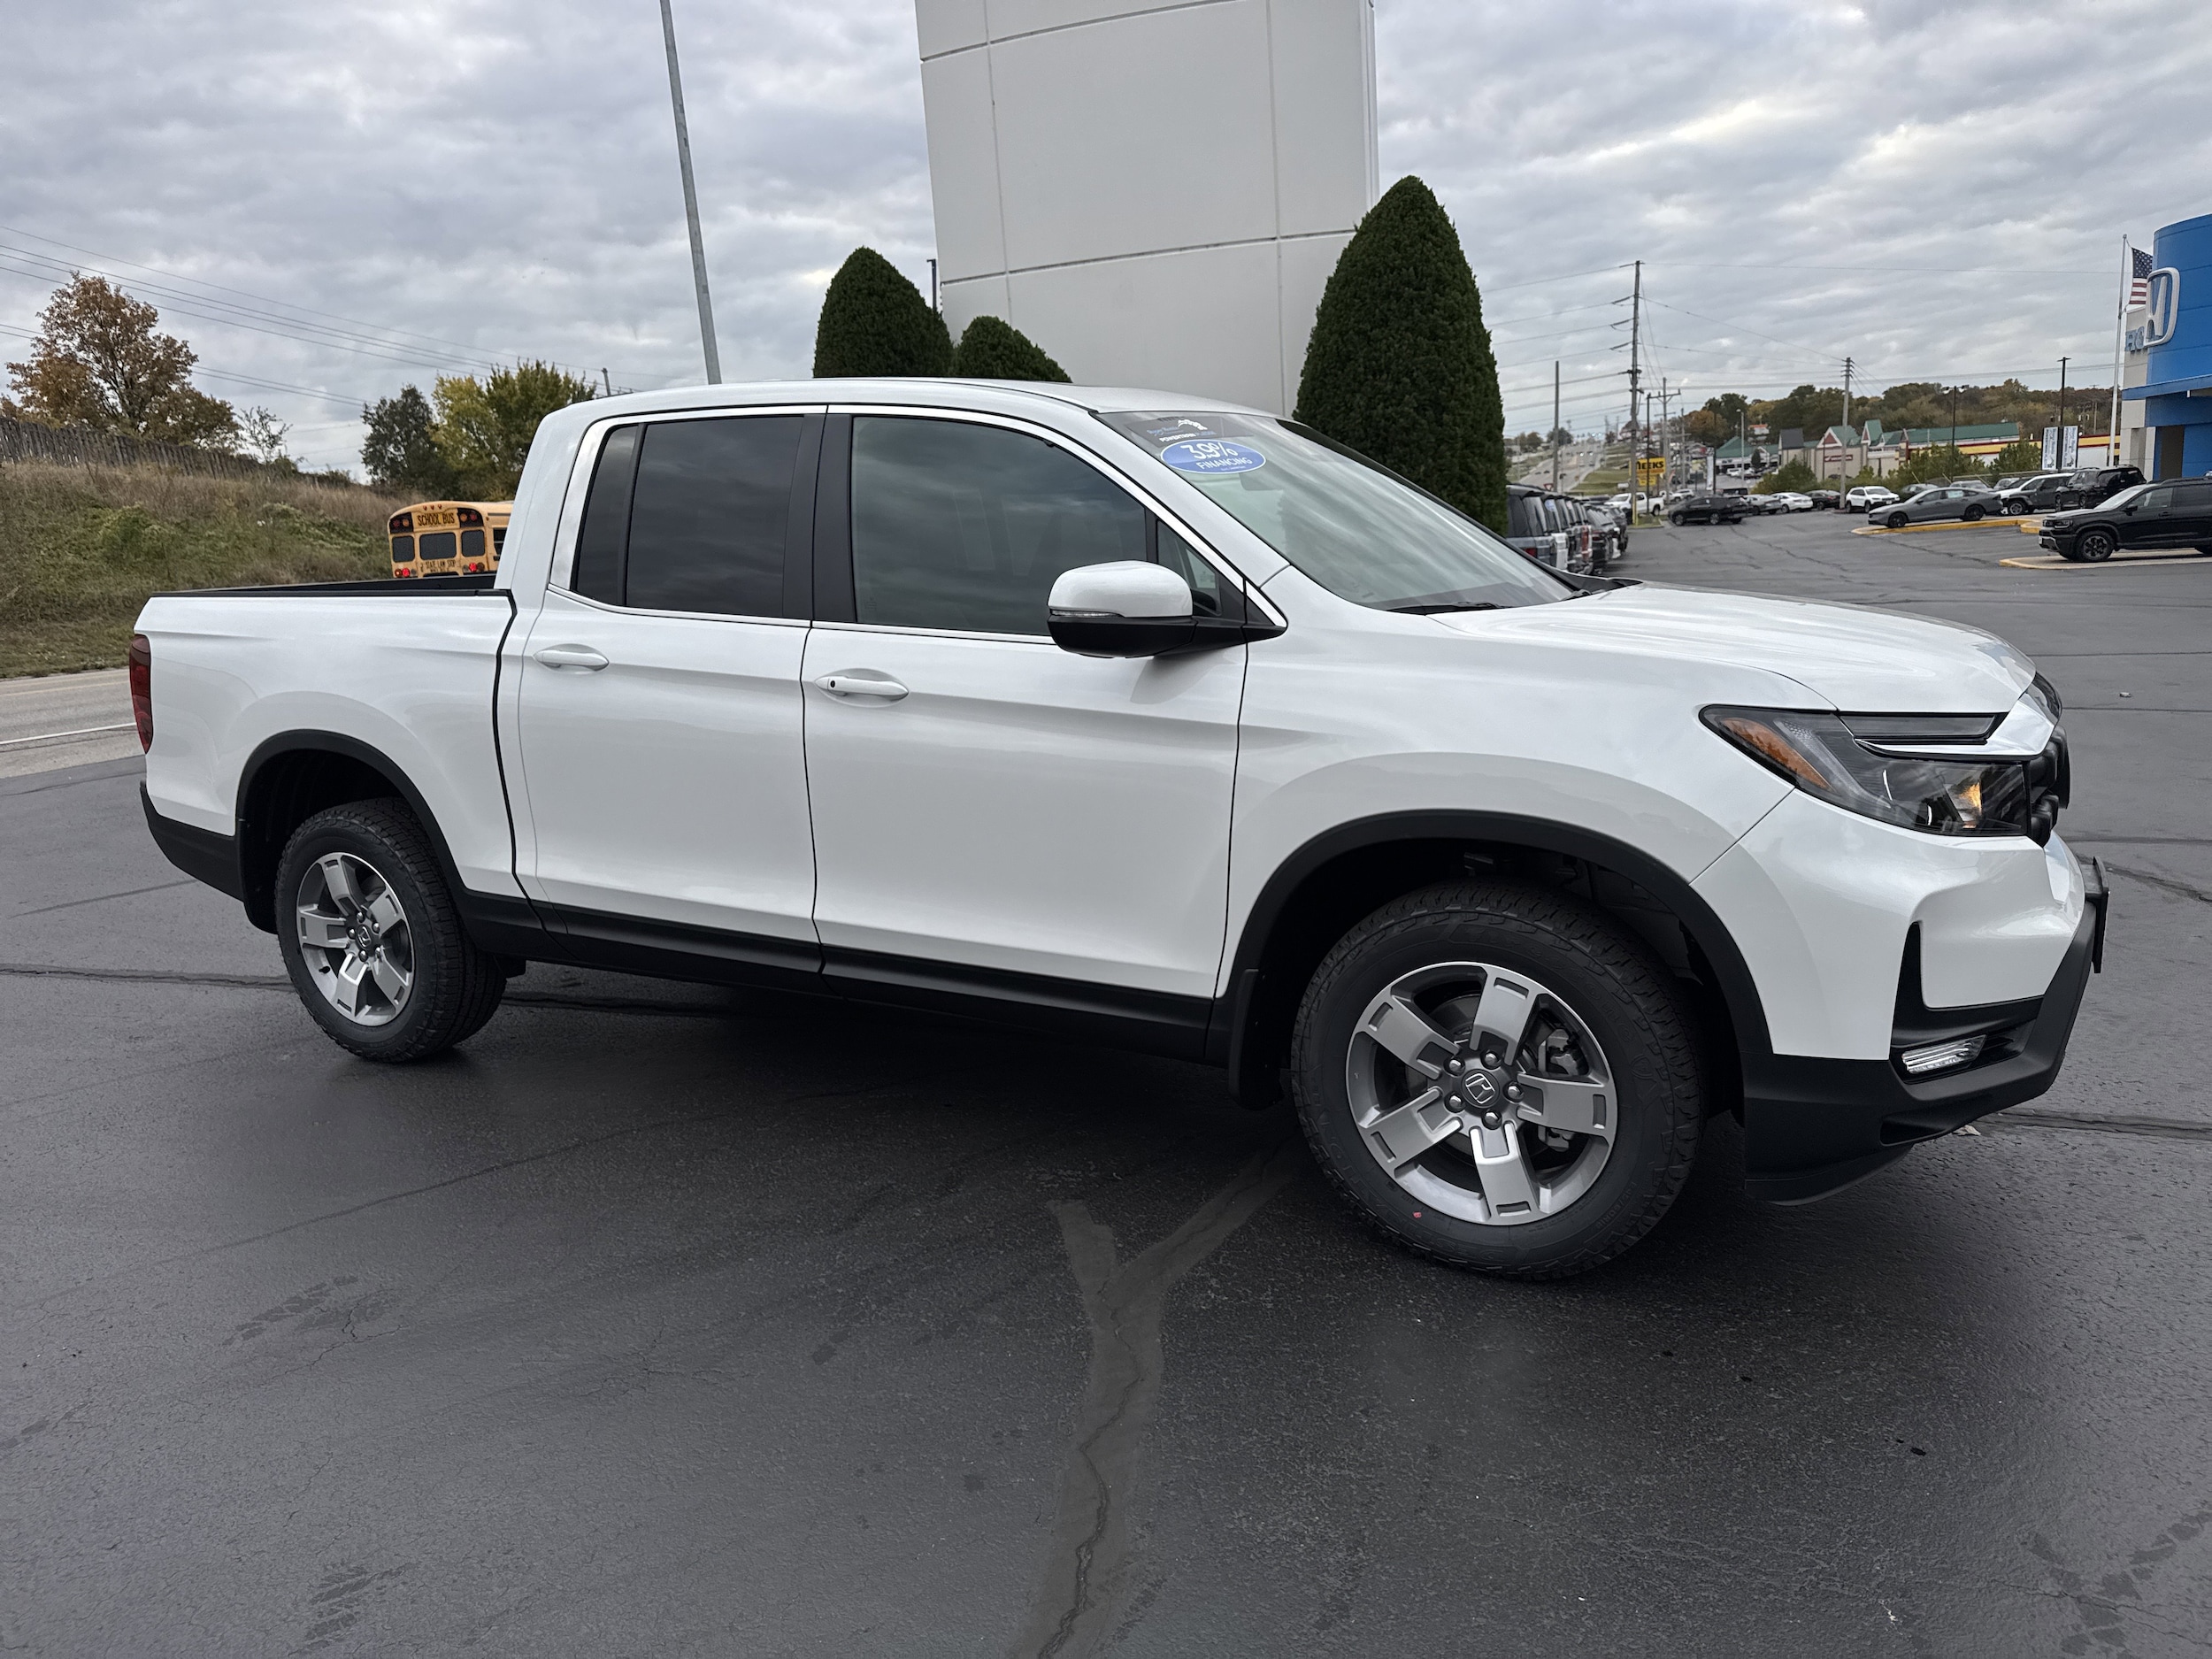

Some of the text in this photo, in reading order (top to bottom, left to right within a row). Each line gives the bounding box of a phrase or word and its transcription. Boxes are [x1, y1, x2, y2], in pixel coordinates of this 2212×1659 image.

[1180, 442, 1239, 459] 3.9%
[1195, 457, 1253, 470] FINANCING
[418, 513, 455, 526] SCHOOL BUS
